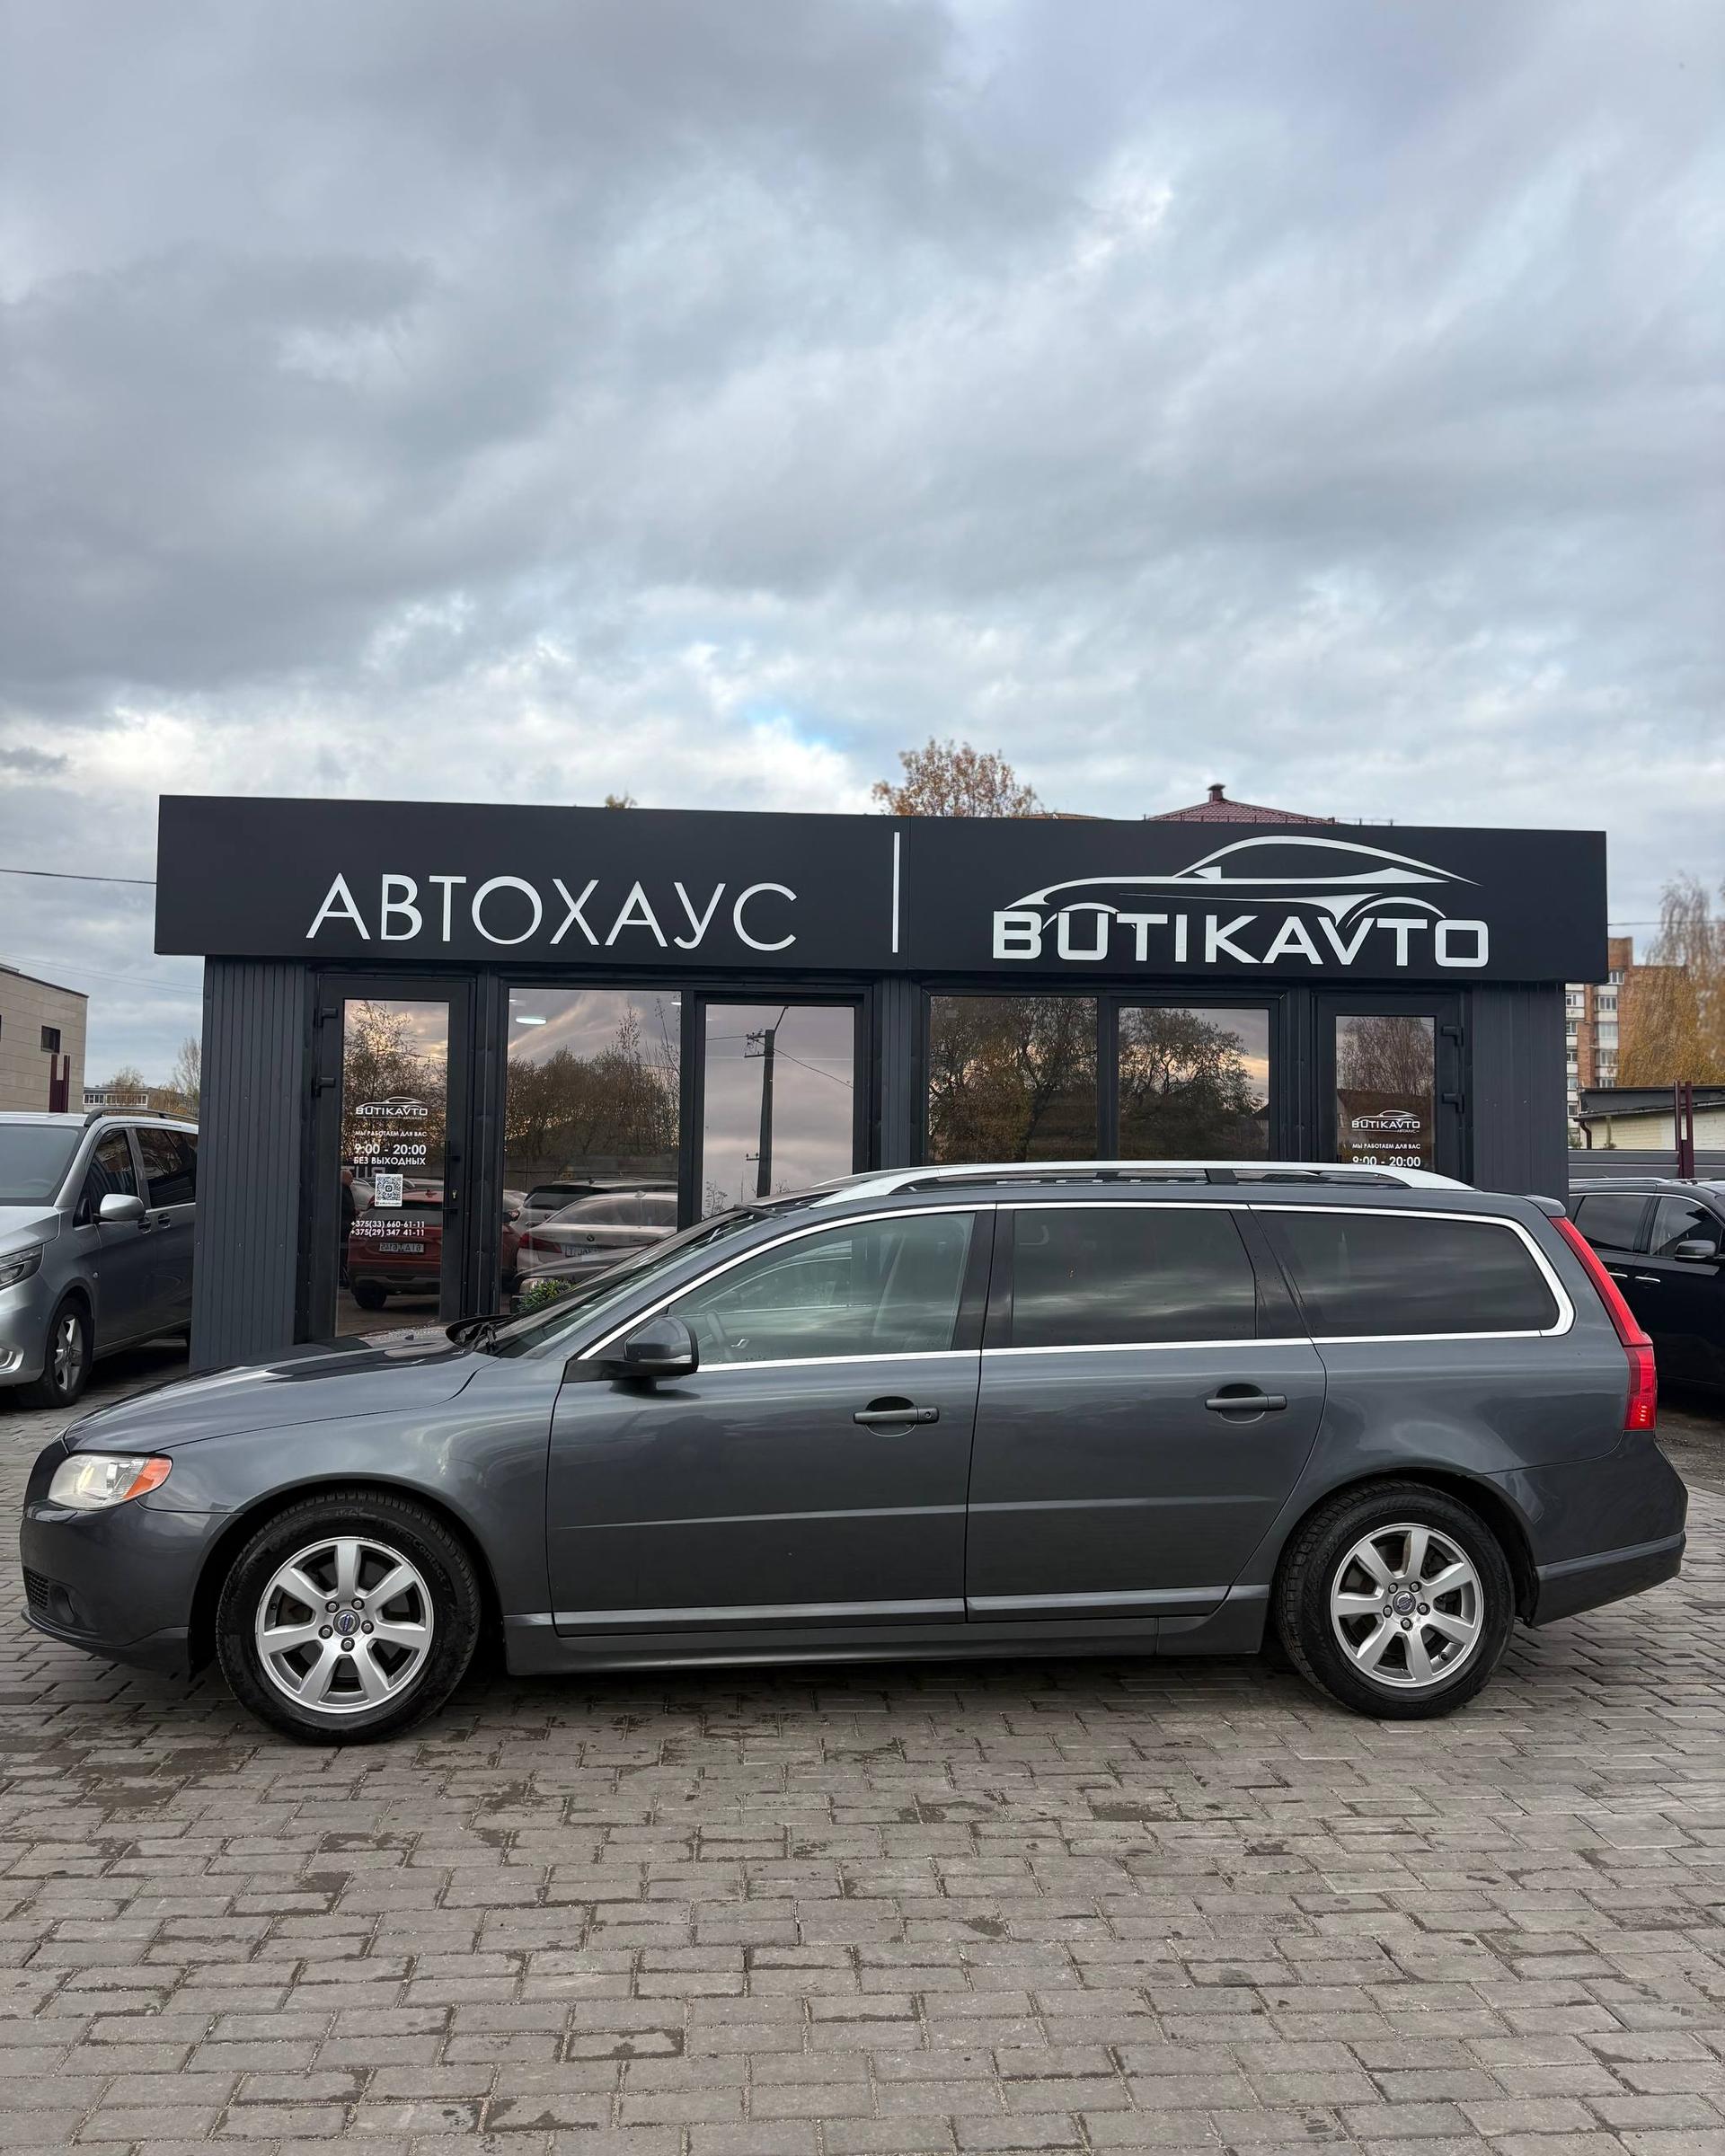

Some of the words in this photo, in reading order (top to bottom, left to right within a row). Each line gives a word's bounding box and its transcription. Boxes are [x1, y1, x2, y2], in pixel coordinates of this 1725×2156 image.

[305, 871, 798, 951] АВТОХАУС
[992, 909, 1490, 968] BUTIKAVTO
[356, 1107, 429, 1116] BUTIKAVTO
[1351, 1120, 1420, 1129] BUTIKAVTO
[354, 1144, 380, 1154] 9:00
[393, 1144, 427, 1155] 20:00
[353, 1156, 369, 1165] БЕЗ
[371, 1157, 426, 1166] ВЫХОДНЫХ
[1389, 1156, 1421, 1167] 20:00
[351, 1221, 385, 1229] +375(33)
[350, 1228, 385, 1237] +375(29)
